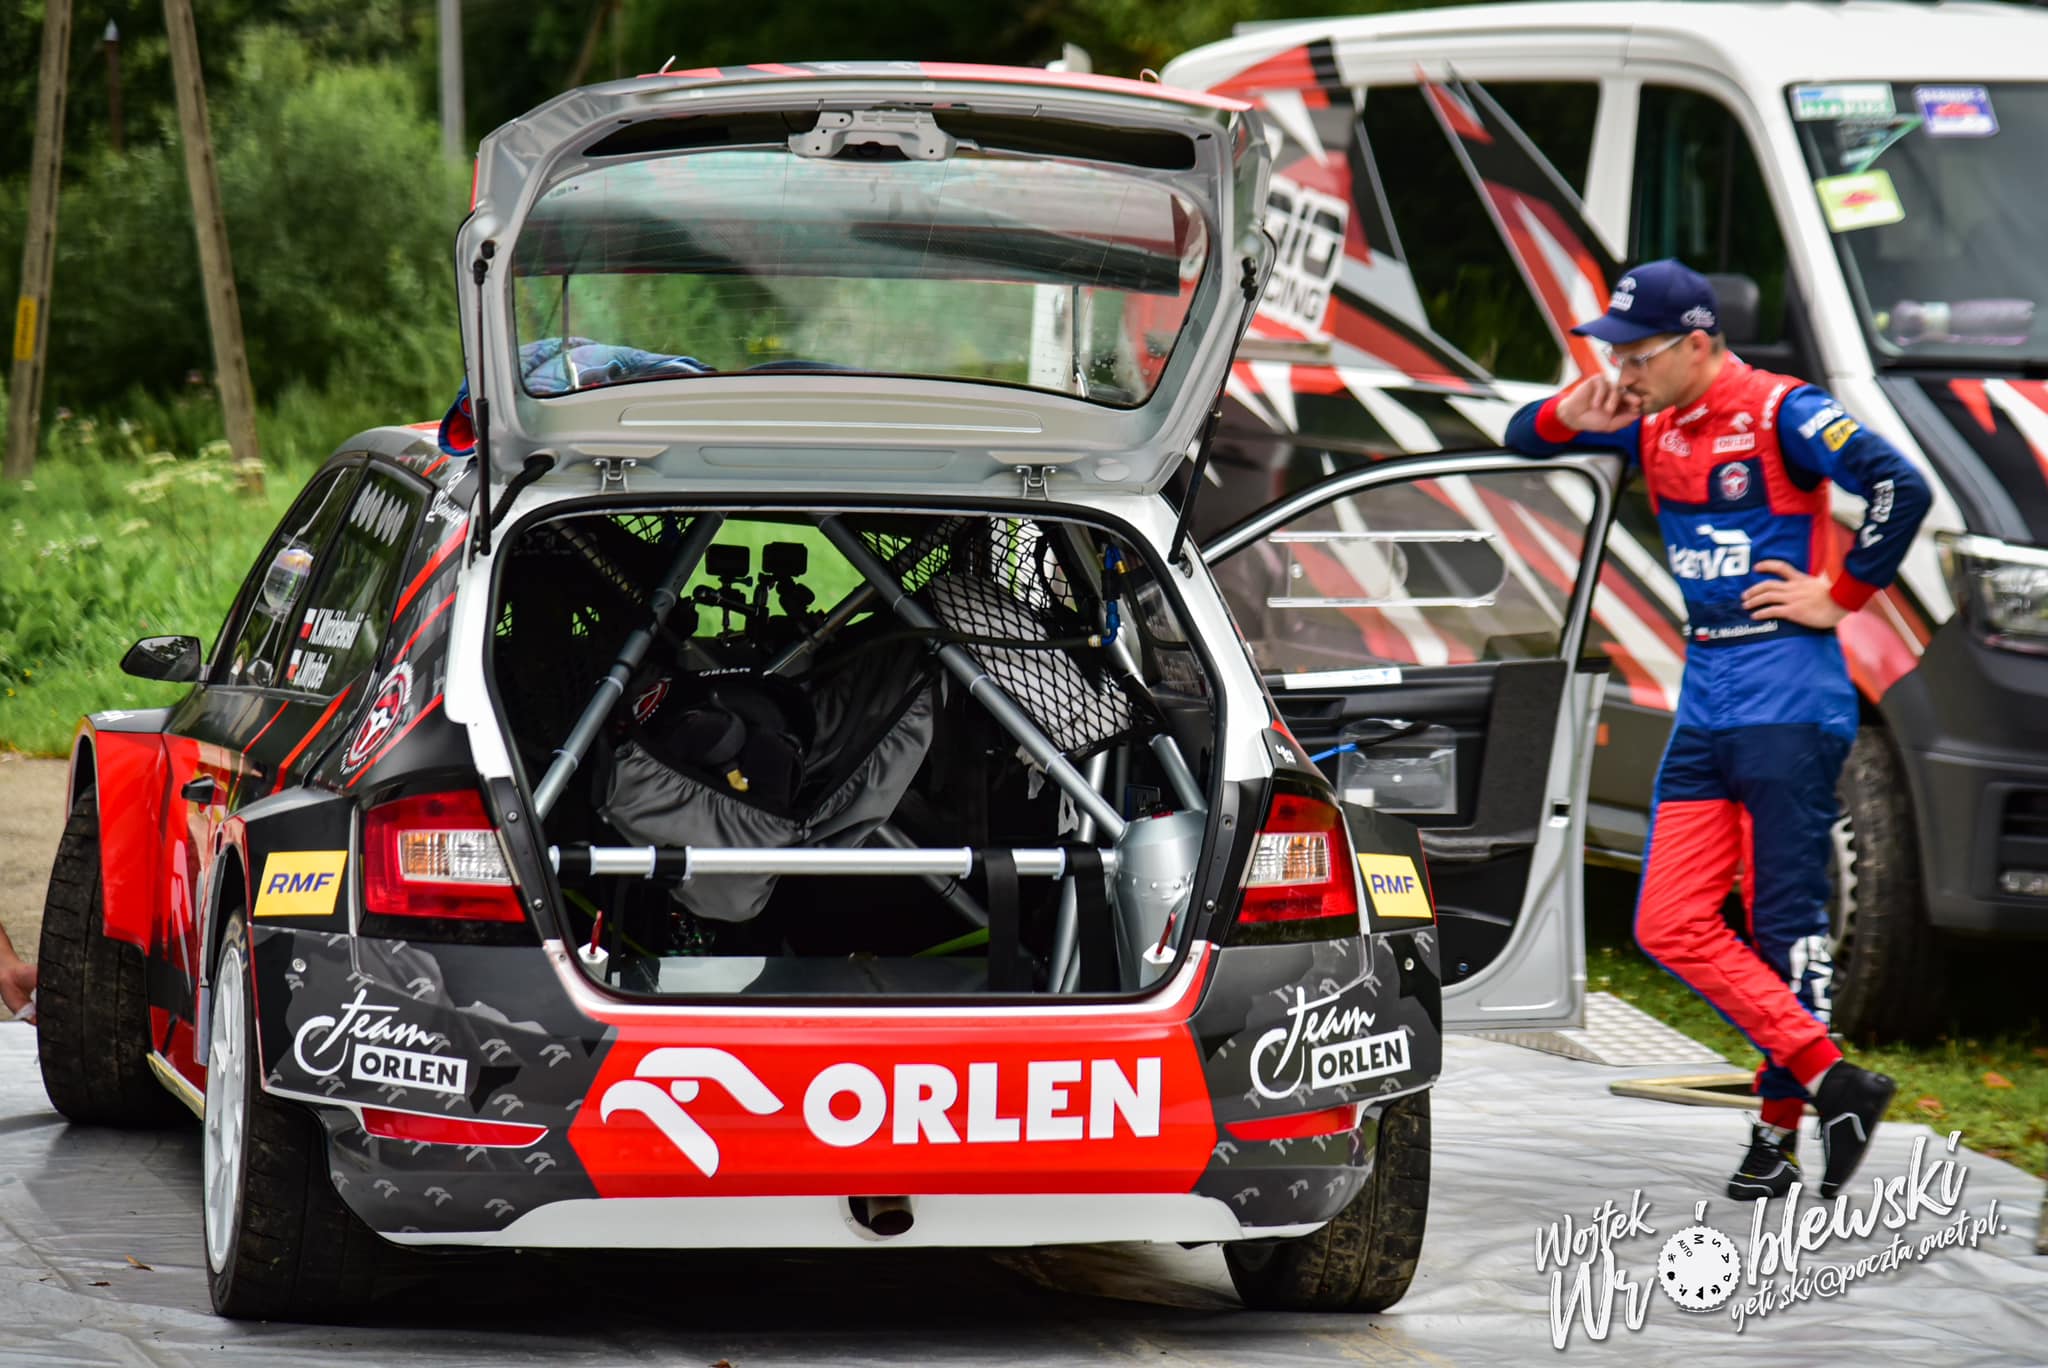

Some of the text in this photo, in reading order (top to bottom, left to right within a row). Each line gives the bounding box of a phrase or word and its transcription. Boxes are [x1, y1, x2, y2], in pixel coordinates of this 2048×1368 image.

[267, 872, 335, 895] RMF
[1370, 873, 1415, 895] RMF
[360, 1052, 459, 1087] ORLEN
[1318, 1038, 1404, 1080] ORLEN
[803, 1057, 1161, 1148] ORLEN
